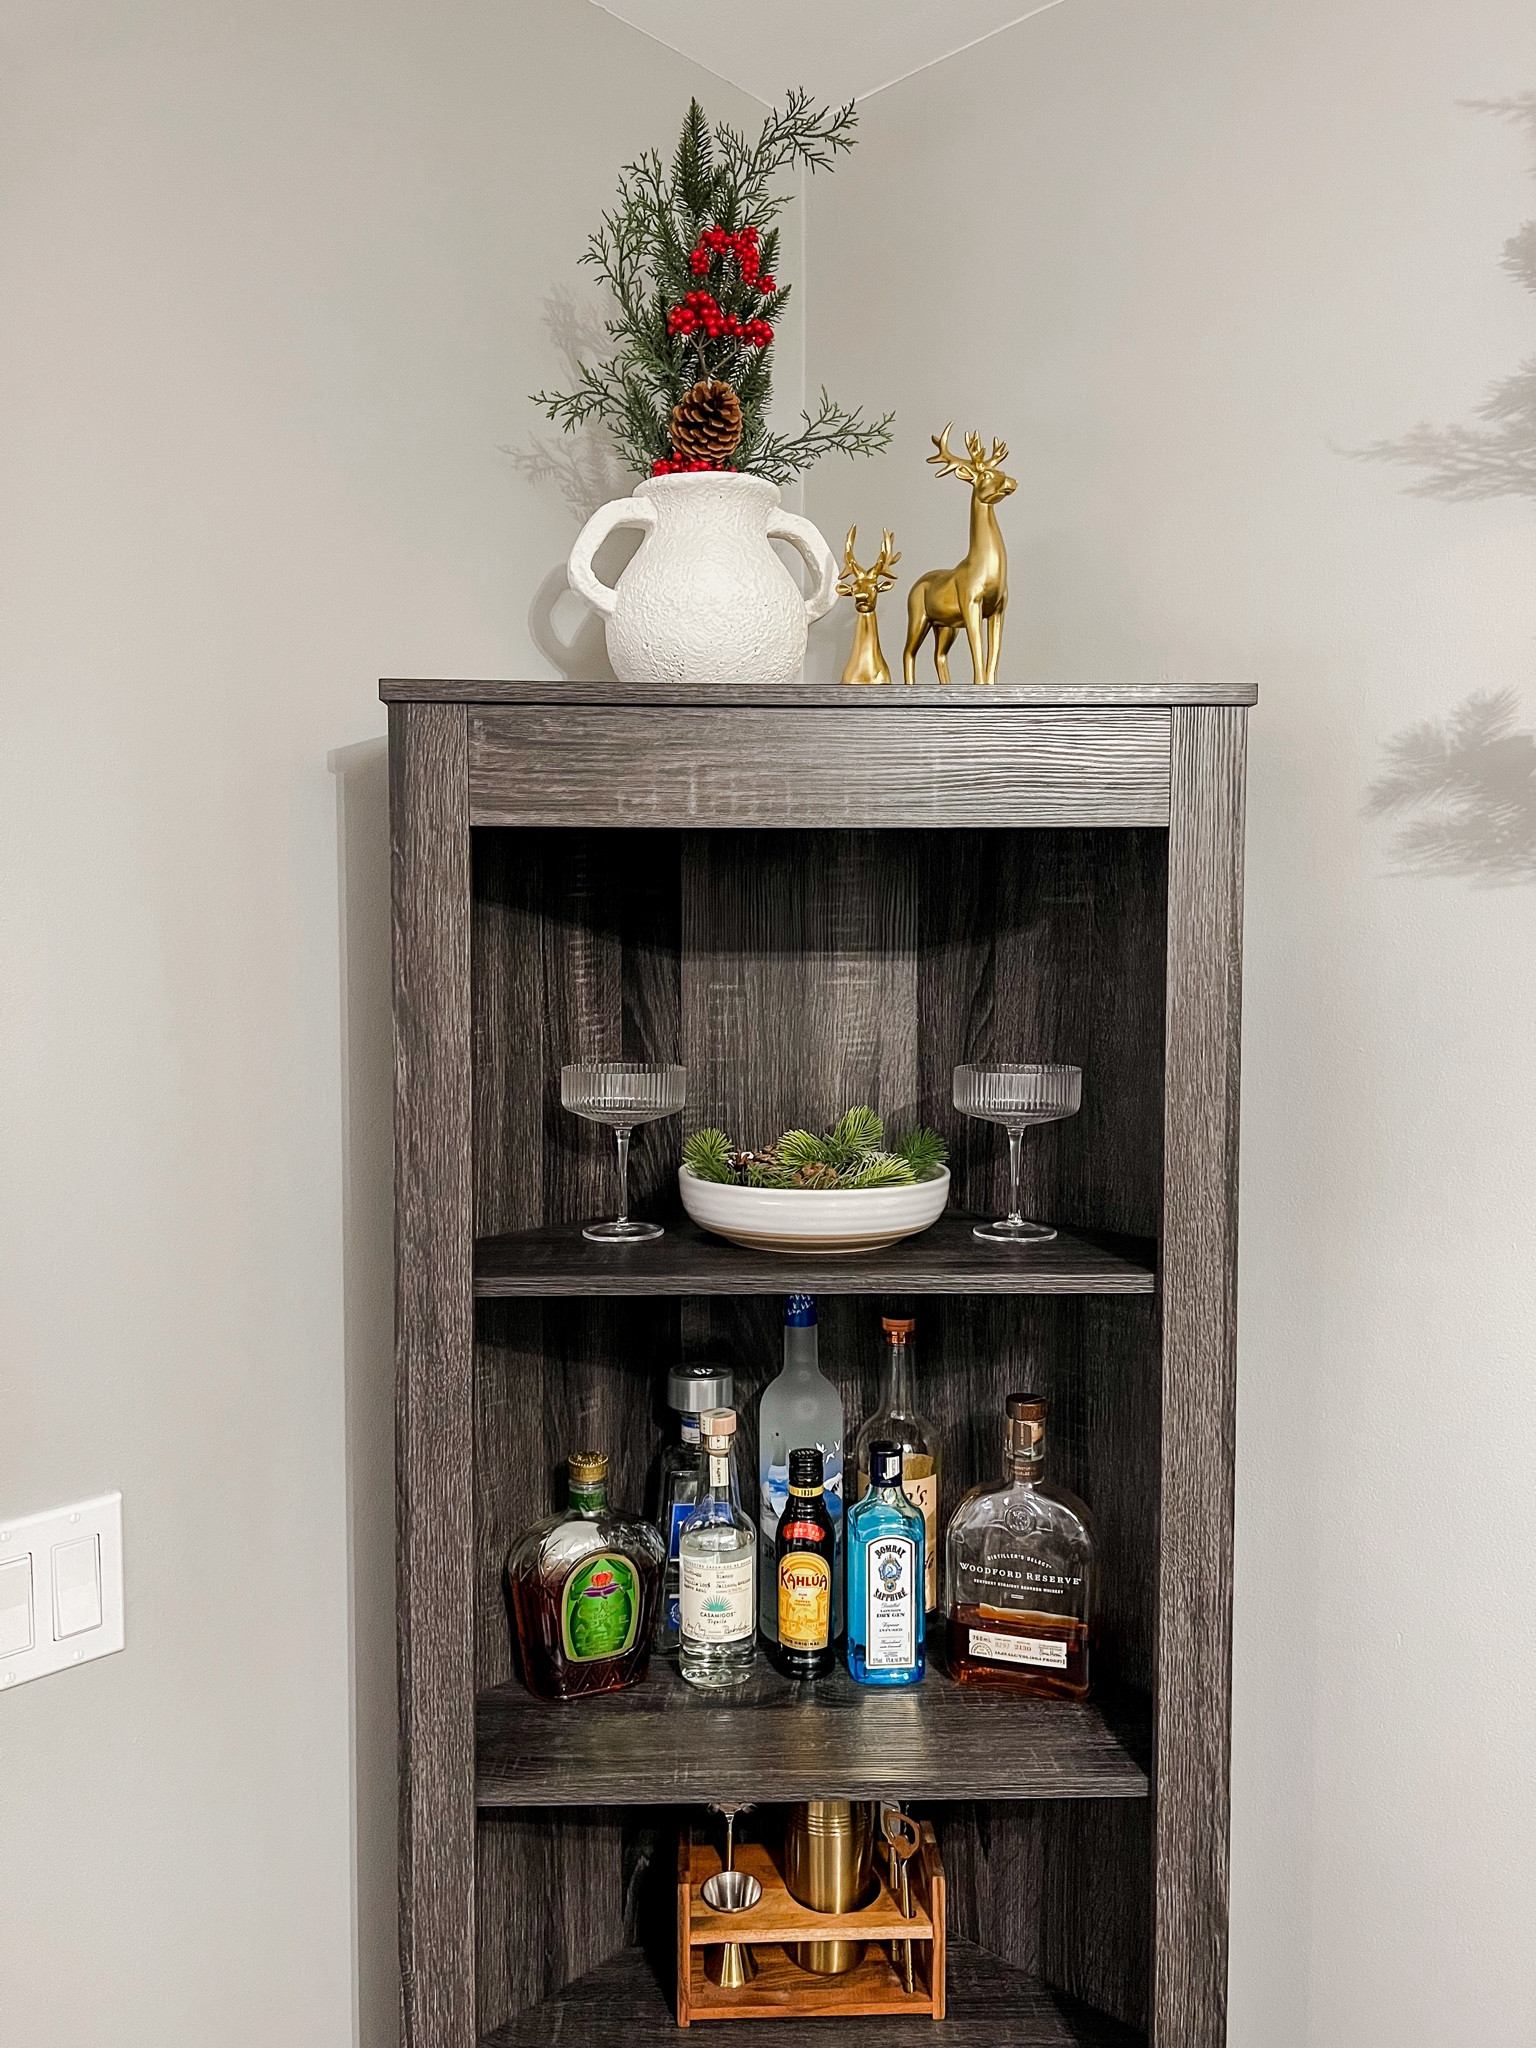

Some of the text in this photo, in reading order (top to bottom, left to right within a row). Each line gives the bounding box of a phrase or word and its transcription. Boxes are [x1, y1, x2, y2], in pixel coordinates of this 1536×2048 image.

[874, 1545, 906, 1560] BOMBAY
[987, 1553, 1024, 1561] DISTILLER'S
[780, 1566, 828, 1591] KAHLÚA
[959, 1562, 1080, 1585] WOODFORD RESERVE
[973, 1578, 997, 1586] KENTUCKY
[873, 1587, 909, 1602] SAPPHIRE
